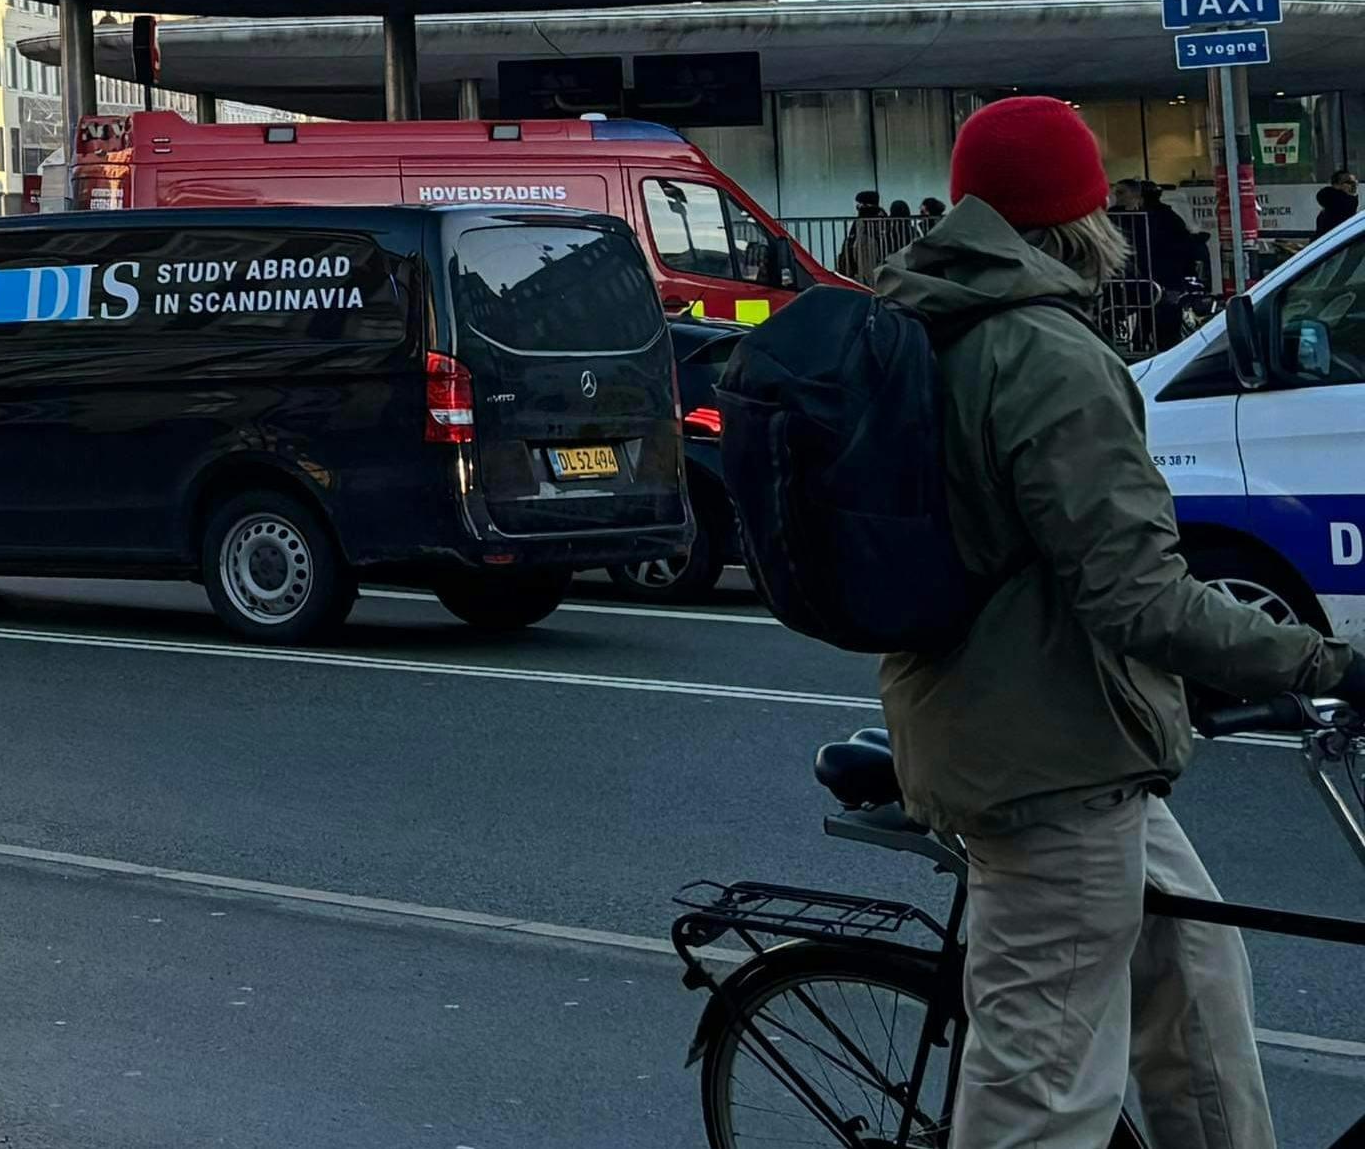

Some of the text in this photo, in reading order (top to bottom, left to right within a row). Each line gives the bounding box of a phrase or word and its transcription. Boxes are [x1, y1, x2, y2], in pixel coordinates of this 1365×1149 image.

[1187, 42, 1257, 56] 3 vogne
[419, 186, 567, 201] HOVEDSTADENS
[156, 256, 351, 284] STUDY ABROAD
[21, 262, 141, 322] DIS
[155, 287, 364, 315] IN SCANDINAVIA
[558, 449, 616, 471] DL 52 494
[1169, 455, 1182, 466] 38
[1185, 455, 1197, 466] 71
[1330, 522, 1363, 566] D
